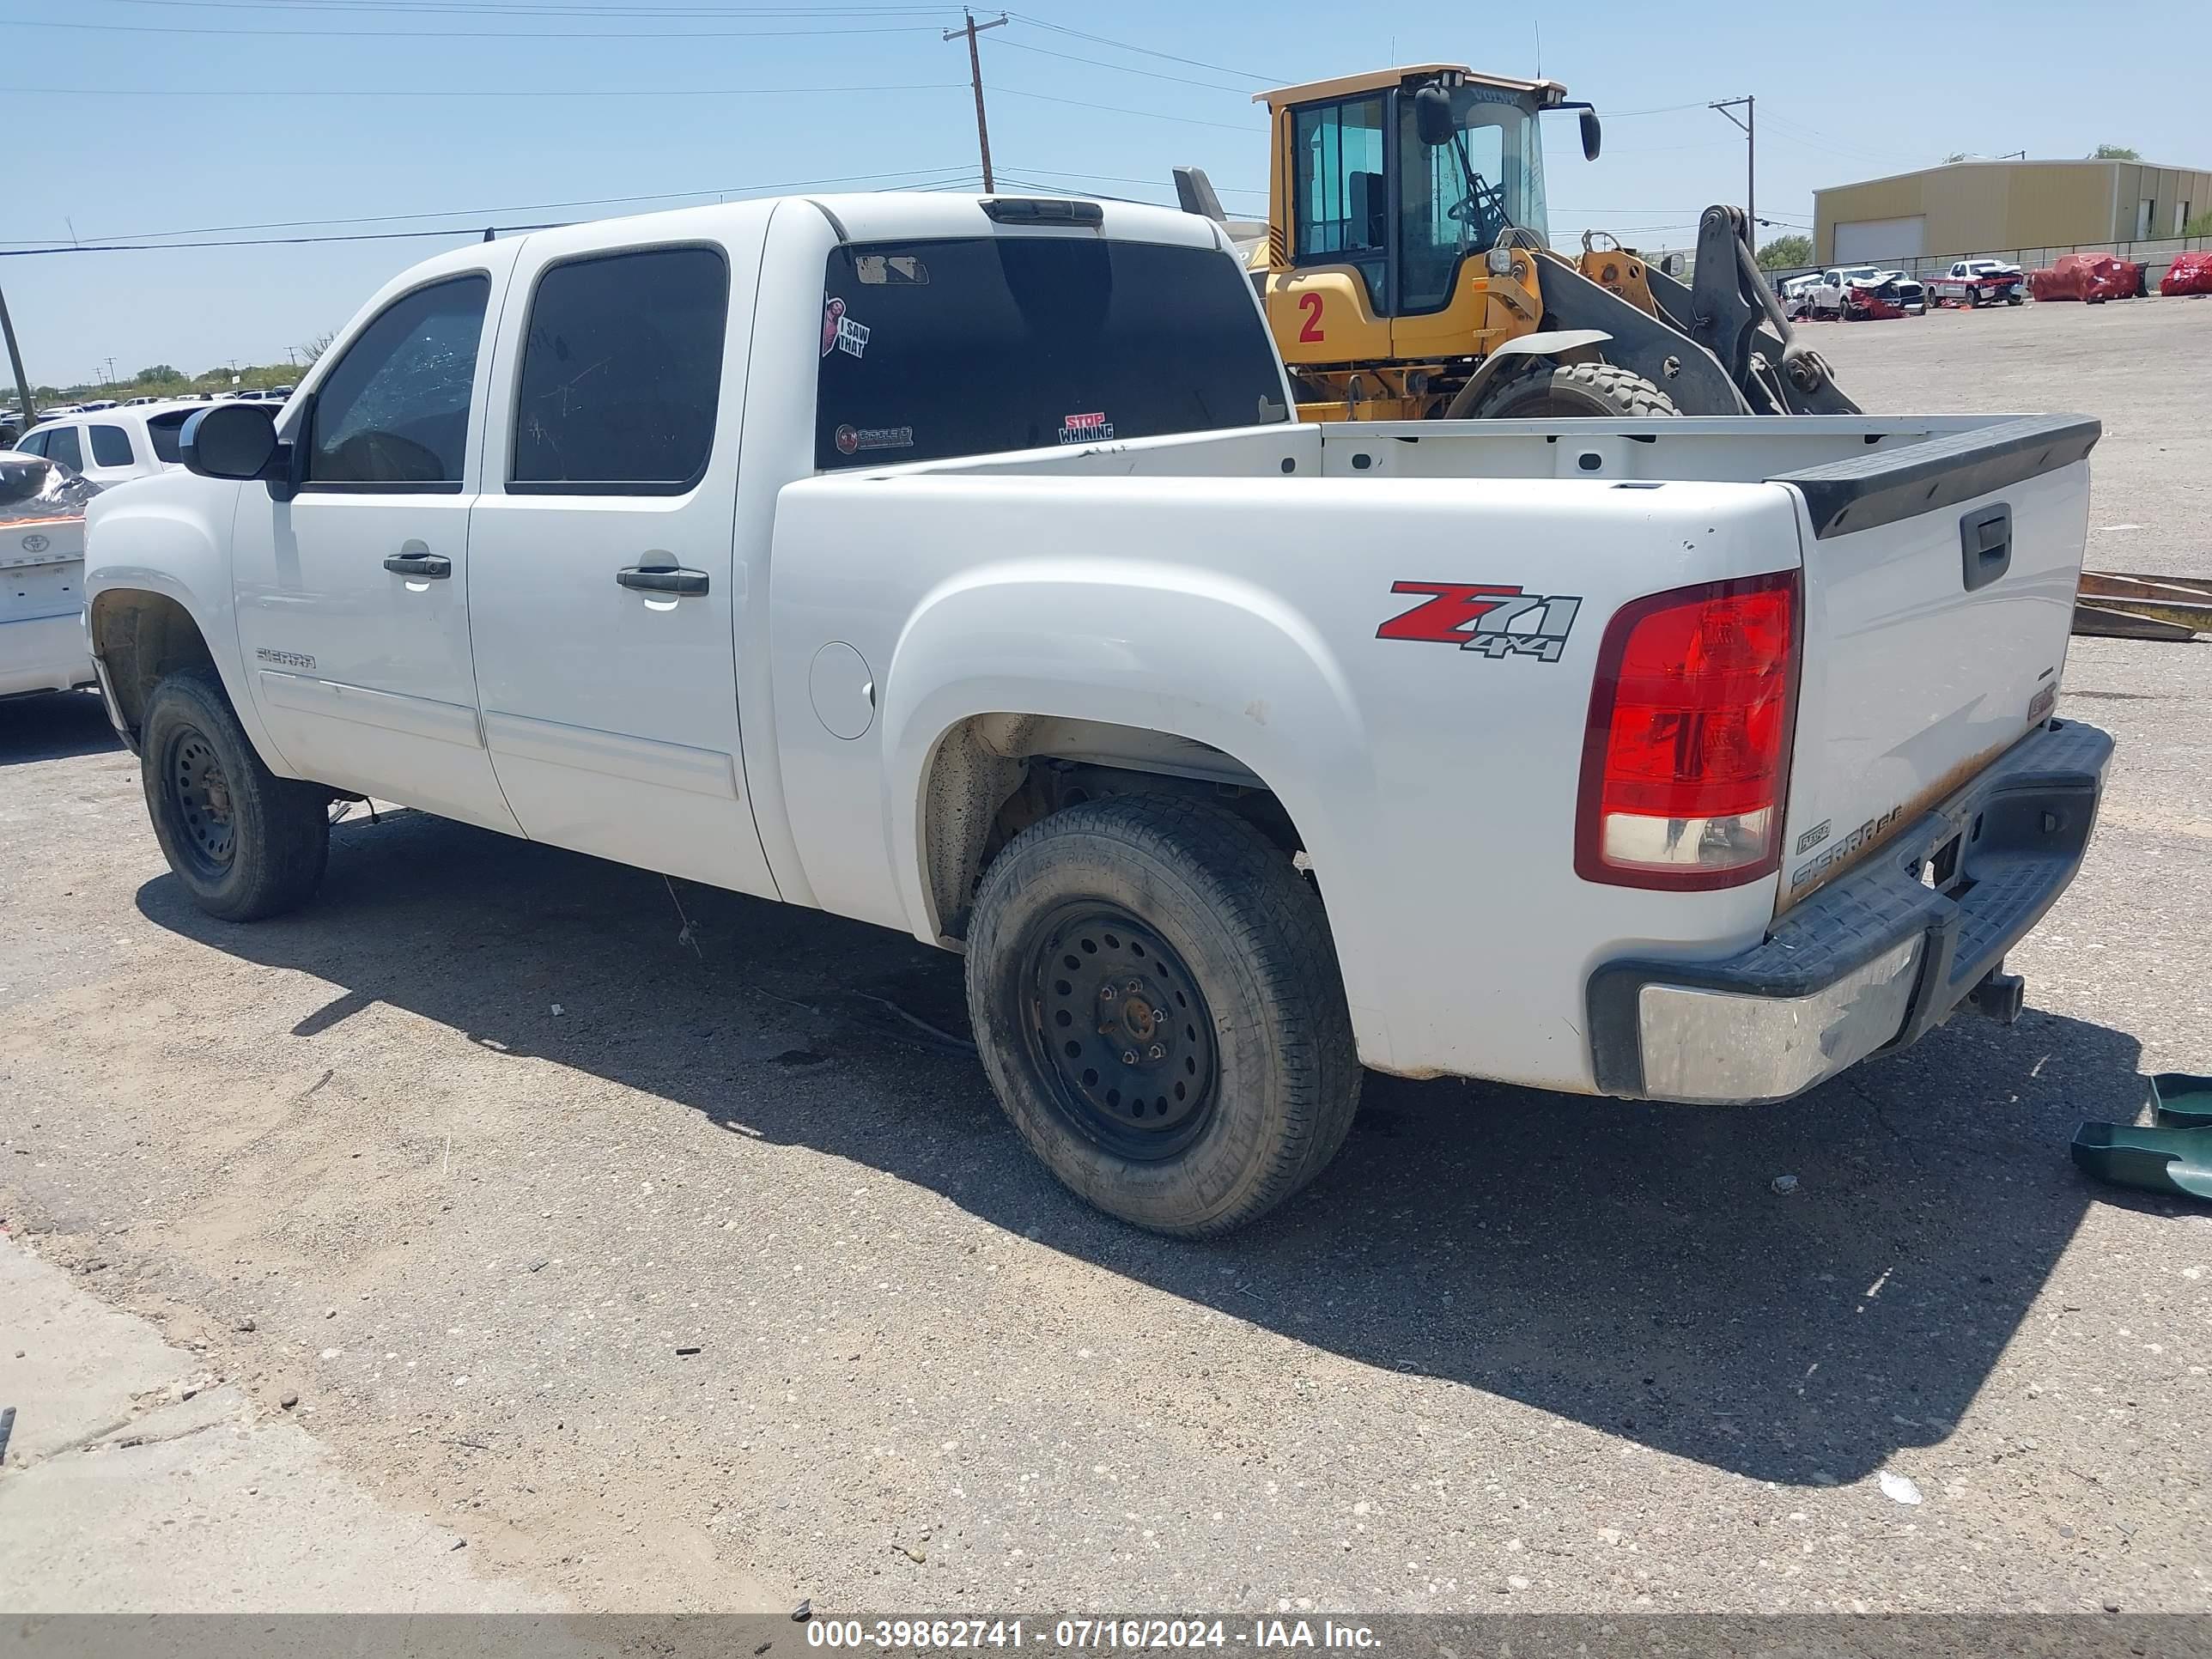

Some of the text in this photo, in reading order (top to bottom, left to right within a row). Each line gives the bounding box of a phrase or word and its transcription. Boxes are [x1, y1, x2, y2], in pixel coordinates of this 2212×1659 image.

[1470, 88, 1520, 105] VOLVO
[1298, 293, 1324, 343] 2
[847, 322, 869, 343] SAW
[840, 335, 863, 356] THAT
[1066, 414, 1104, 428] STOP
[1059, 424, 1113, 444] WHINING
[1375, 580, 1583, 644] Z71
[256, 647, 317, 669] SIERRA
[1791, 818, 1877, 891] SIERRA
